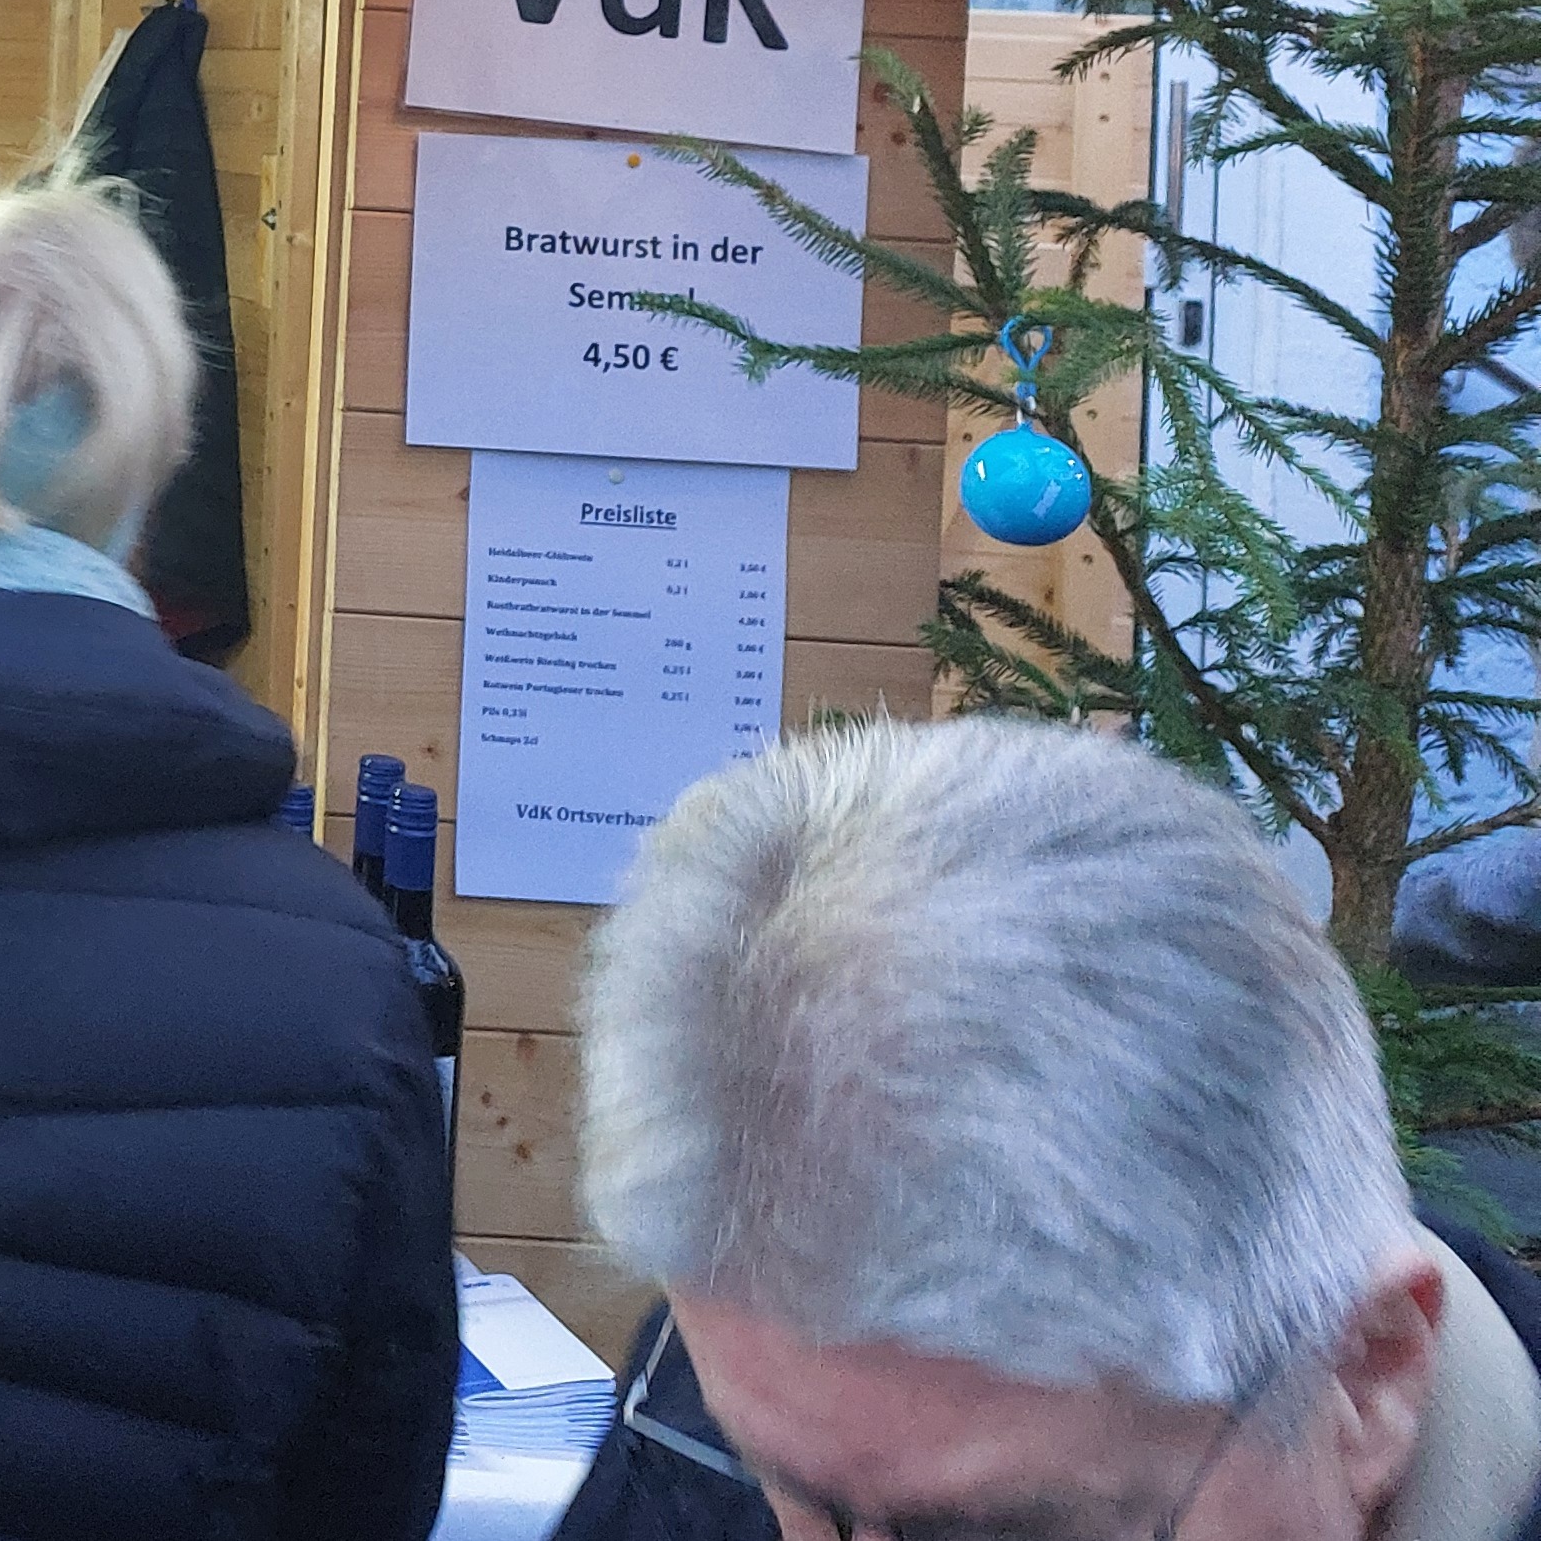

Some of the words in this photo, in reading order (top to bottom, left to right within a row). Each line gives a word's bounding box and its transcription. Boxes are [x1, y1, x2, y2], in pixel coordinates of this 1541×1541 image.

[504, 225, 662, 260] Bratwurst
[672, 233, 699, 262] in
[710, 235, 764, 265] der
[582, 342, 651, 374] 4,50
[659, 345, 679, 372] €
[580, 503, 678, 527] Preisliste
[515, 803, 553, 822] VdK
[556, 806, 661, 827] Ortsverban
